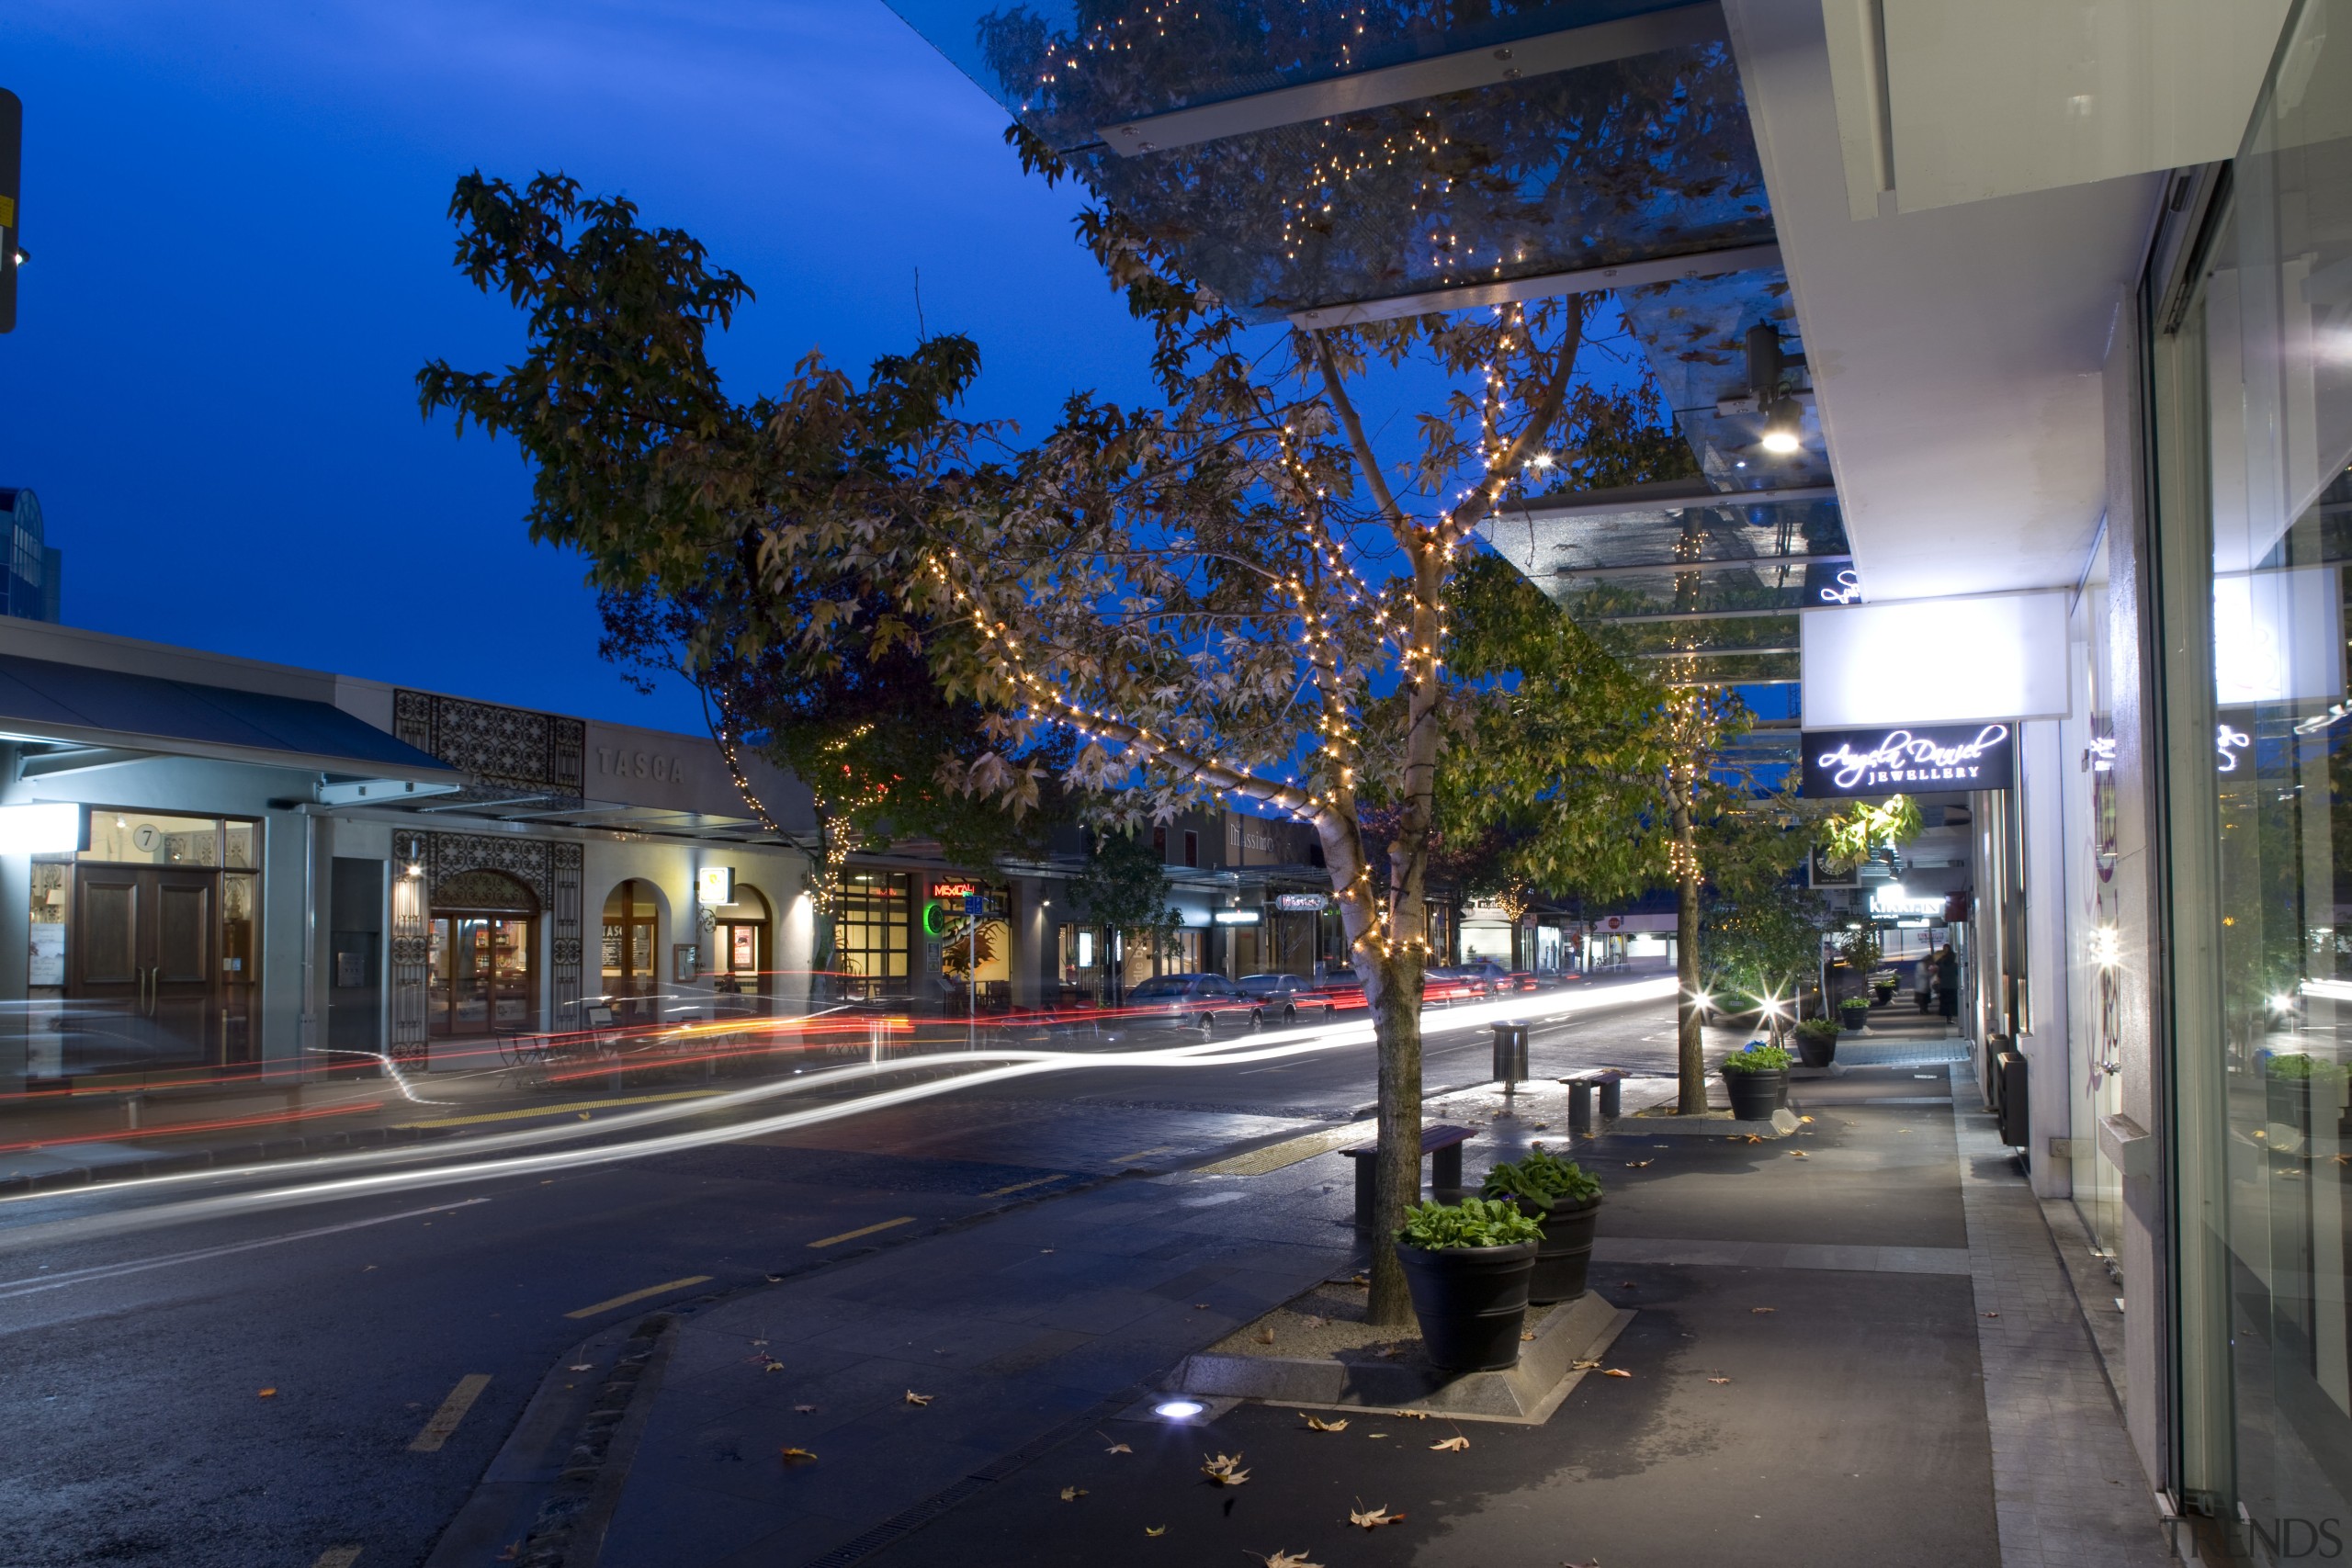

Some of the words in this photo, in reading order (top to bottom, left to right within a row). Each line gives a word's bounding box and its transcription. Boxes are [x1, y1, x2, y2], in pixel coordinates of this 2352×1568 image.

[596, 747, 684, 784] TASCA
[1819, 729, 1912, 788] Angela
[1868, 765, 1980, 785] JEWELLERY
[142, 829, 152, 846] 7
